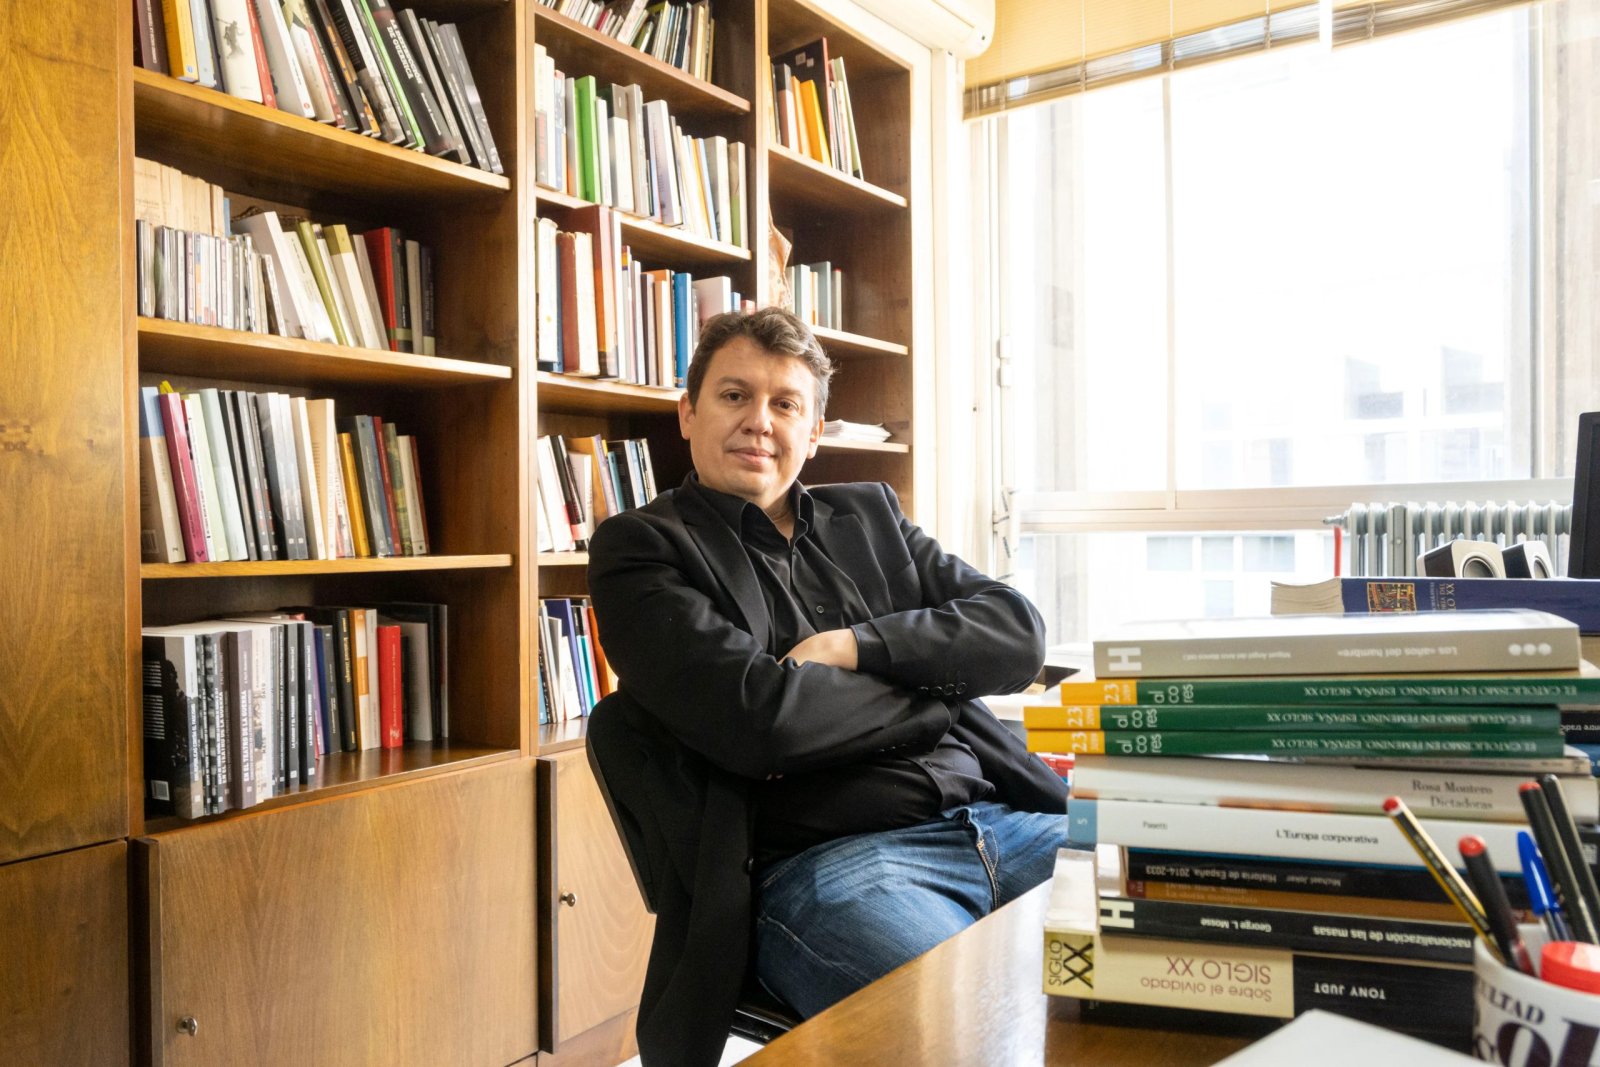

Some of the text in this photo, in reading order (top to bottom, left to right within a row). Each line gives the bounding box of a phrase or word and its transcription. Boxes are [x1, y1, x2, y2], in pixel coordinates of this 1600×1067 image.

[386, 26, 396, 38] DE
[392, 38, 414, 80] GUERNICA
[1385, 648, 1402, 658] del
[1437, 646, 1458, 656] Los
[1107, 647, 1142, 672] H
[1104, 683, 1120, 704] 23
[1168, 686, 1179, 704] co
[1182, 684, 1194, 703] res
[1304, 686, 1318, 696] XX
[1320, 686, 1352, 696] SIGLO
[1462, 686, 1478, 696] EN
[1480, 686, 1560, 696] CATOLICISMO
[1562, 686, 1577, 696] EL
[240, 690, 248, 718] GUERRA
[241, 718, 248, 726] LA
[1067, 706, 1083, 728] 23
[1132, 710, 1142, 728] co
[1146, 708, 1158, 728] res
[1266, 713, 1281, 722] XX
[1282, 713, 1314, 722] SIGLO
[1420, 714, 1436, 724] EN
[1437, 714, 1517, 724] CATOLICISMO
[1518, 714, 1532, 724] EL
[242, 726, 248, 736] DE
[1561, 724, 1582, 732] tradic
[1072, 732, 1087, 752] 23
[1136, 734, 1147, 753] co
[1151, 733, 1162, 753] res
[1272, 739, 1286, 748] XX
[1286, 739, 1318, 749] SIGLO
[1426, 740, 1441, 750] EN
[1443, 741, 1522, 751] CATOLICISMO
[1524, 742, 1537, 751] EL
[1412, 779, 1493, 794] Rosa Montero
[1430, 796, 1493, 809] Dictadoras
[1276, 828, 1378, 844] L'Europa corporativa
[1228, 871, 1240, 880] de
[1242, 872, 1277, 883] Historia
[1200, 917, 1272, 933] George L. Mosse
[1312, 926, 1472, 948] nacionalización de las masas
[1048, 940, 1063, 986] SIGLO
[1062, 941, 1094, 989] XX
[1166, 956, 1272, 984] SIGLO XX
[1140, 976, 1272, 1002] Sobre el olvidado
[1313, 982, 1386, 1000] TONY JUDT
